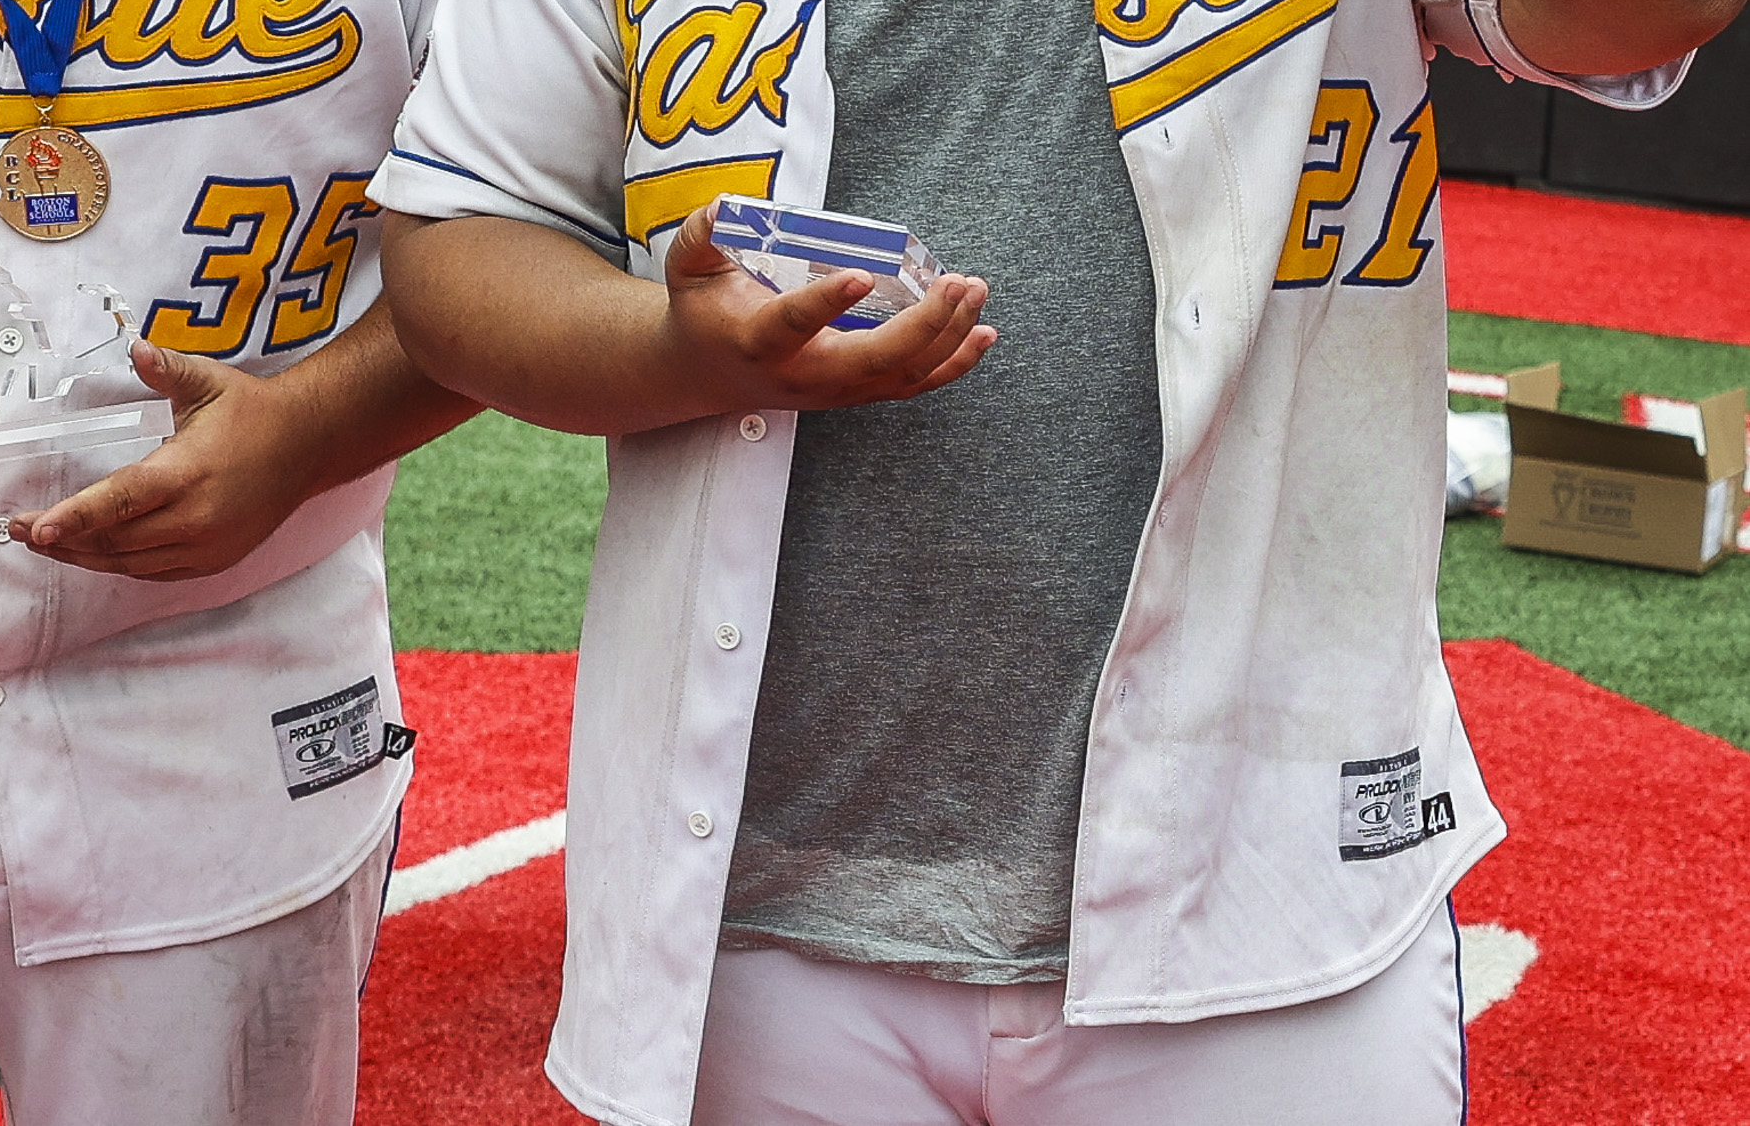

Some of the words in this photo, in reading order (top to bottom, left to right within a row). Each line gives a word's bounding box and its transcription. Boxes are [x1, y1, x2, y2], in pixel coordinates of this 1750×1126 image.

[1273, 78, 1441, 289] 21
[30, 196, 72, 207] BOSTON
[33, 203, 71, 214] PUBLIC
[29, 209, 76, 220] SCHOOLS
[141, 171, 381, 359] 35
[1428, 802, 1451, 833] 44
